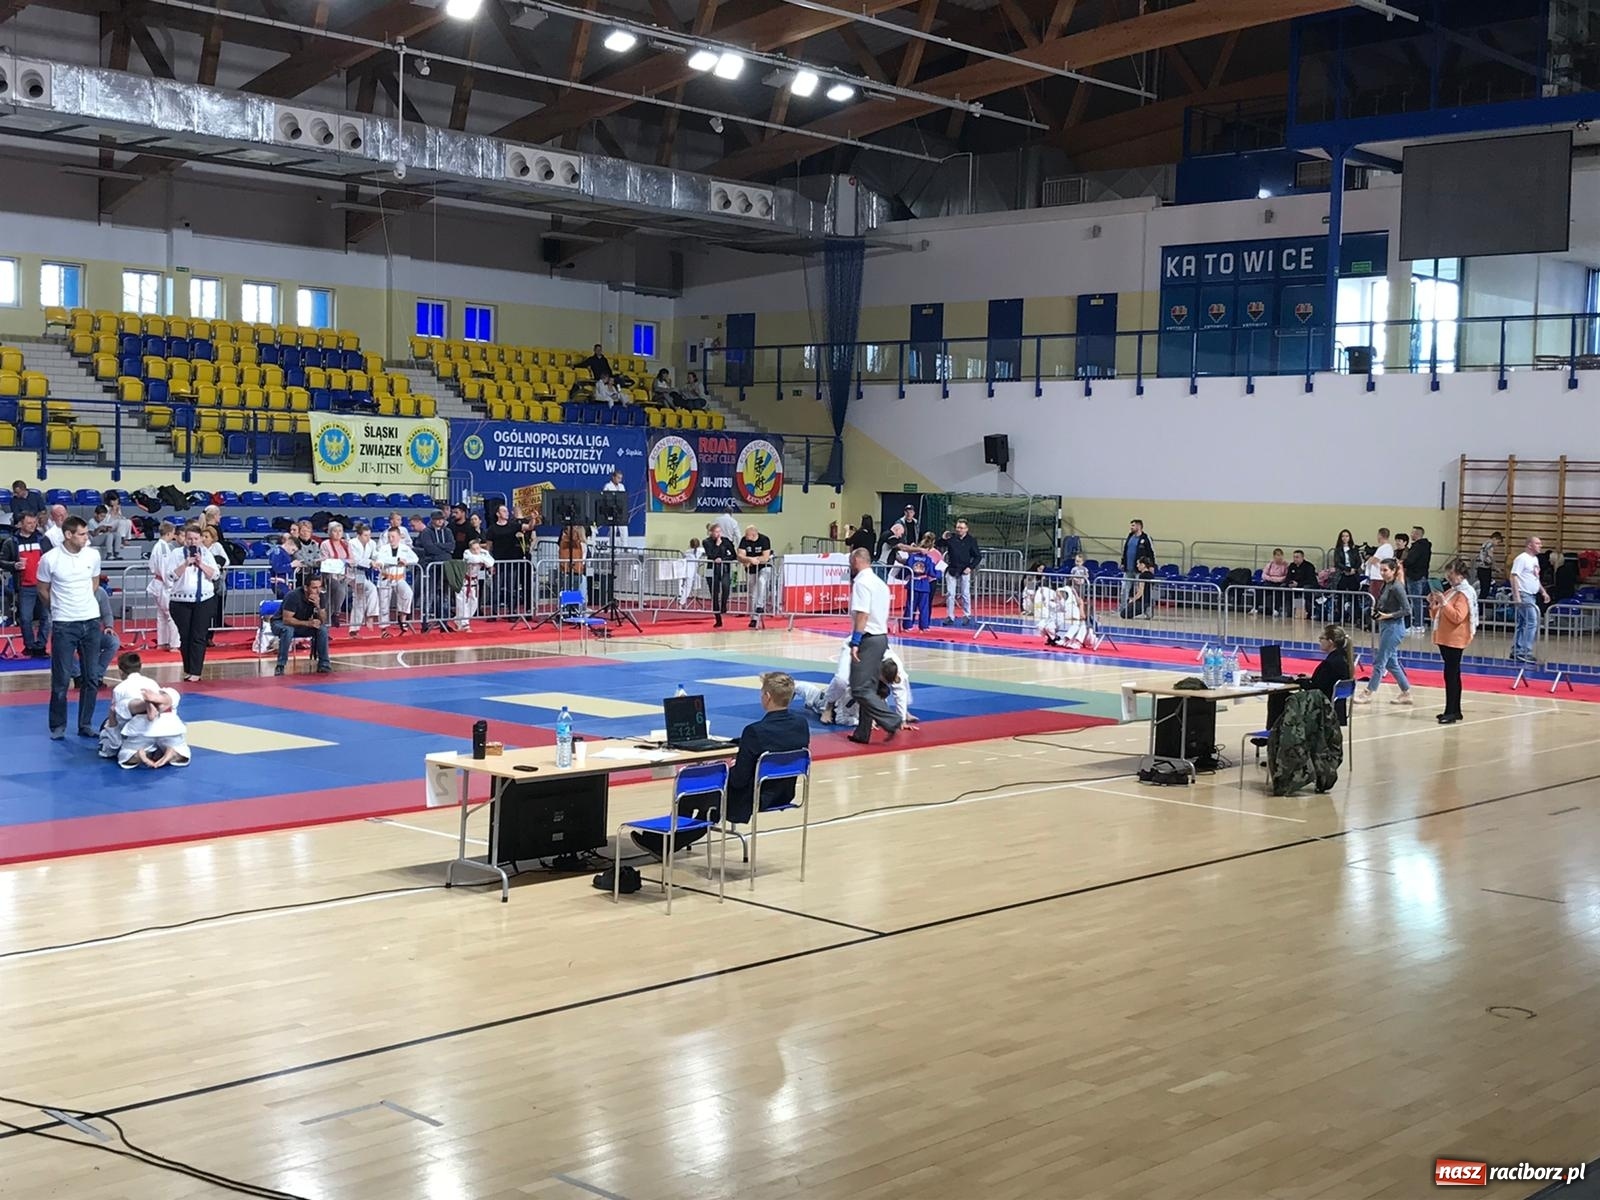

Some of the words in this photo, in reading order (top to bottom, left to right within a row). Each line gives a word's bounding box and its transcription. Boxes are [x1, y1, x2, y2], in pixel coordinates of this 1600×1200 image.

[364, 422, 398, 440] ŚLĄSKI
[493, 428, 583, 446] OGÓLNOPOLSKA
[586, 435, 610, 447] LIGA
[360, 444, 402, 459] ZWIĄZEK
[499, 445, 534, 458] DZIECI
[536, 448, 540, 459] I
[541, 446, 603, 460] MŁODZIEŻY
[358, 462, 403, 475] JU-JITSU
[484, 459, 496, 471] W
[498, 460, 511, 472] JU
[513, 461, 543, 473] JITSU
[545, 462, 615, 475] SPORTOWYM
[700, 477, 733, 487] JU-JITSU
[697, 497, 737, 507] KATOWICE
[695, 711, 704, 724] 6
